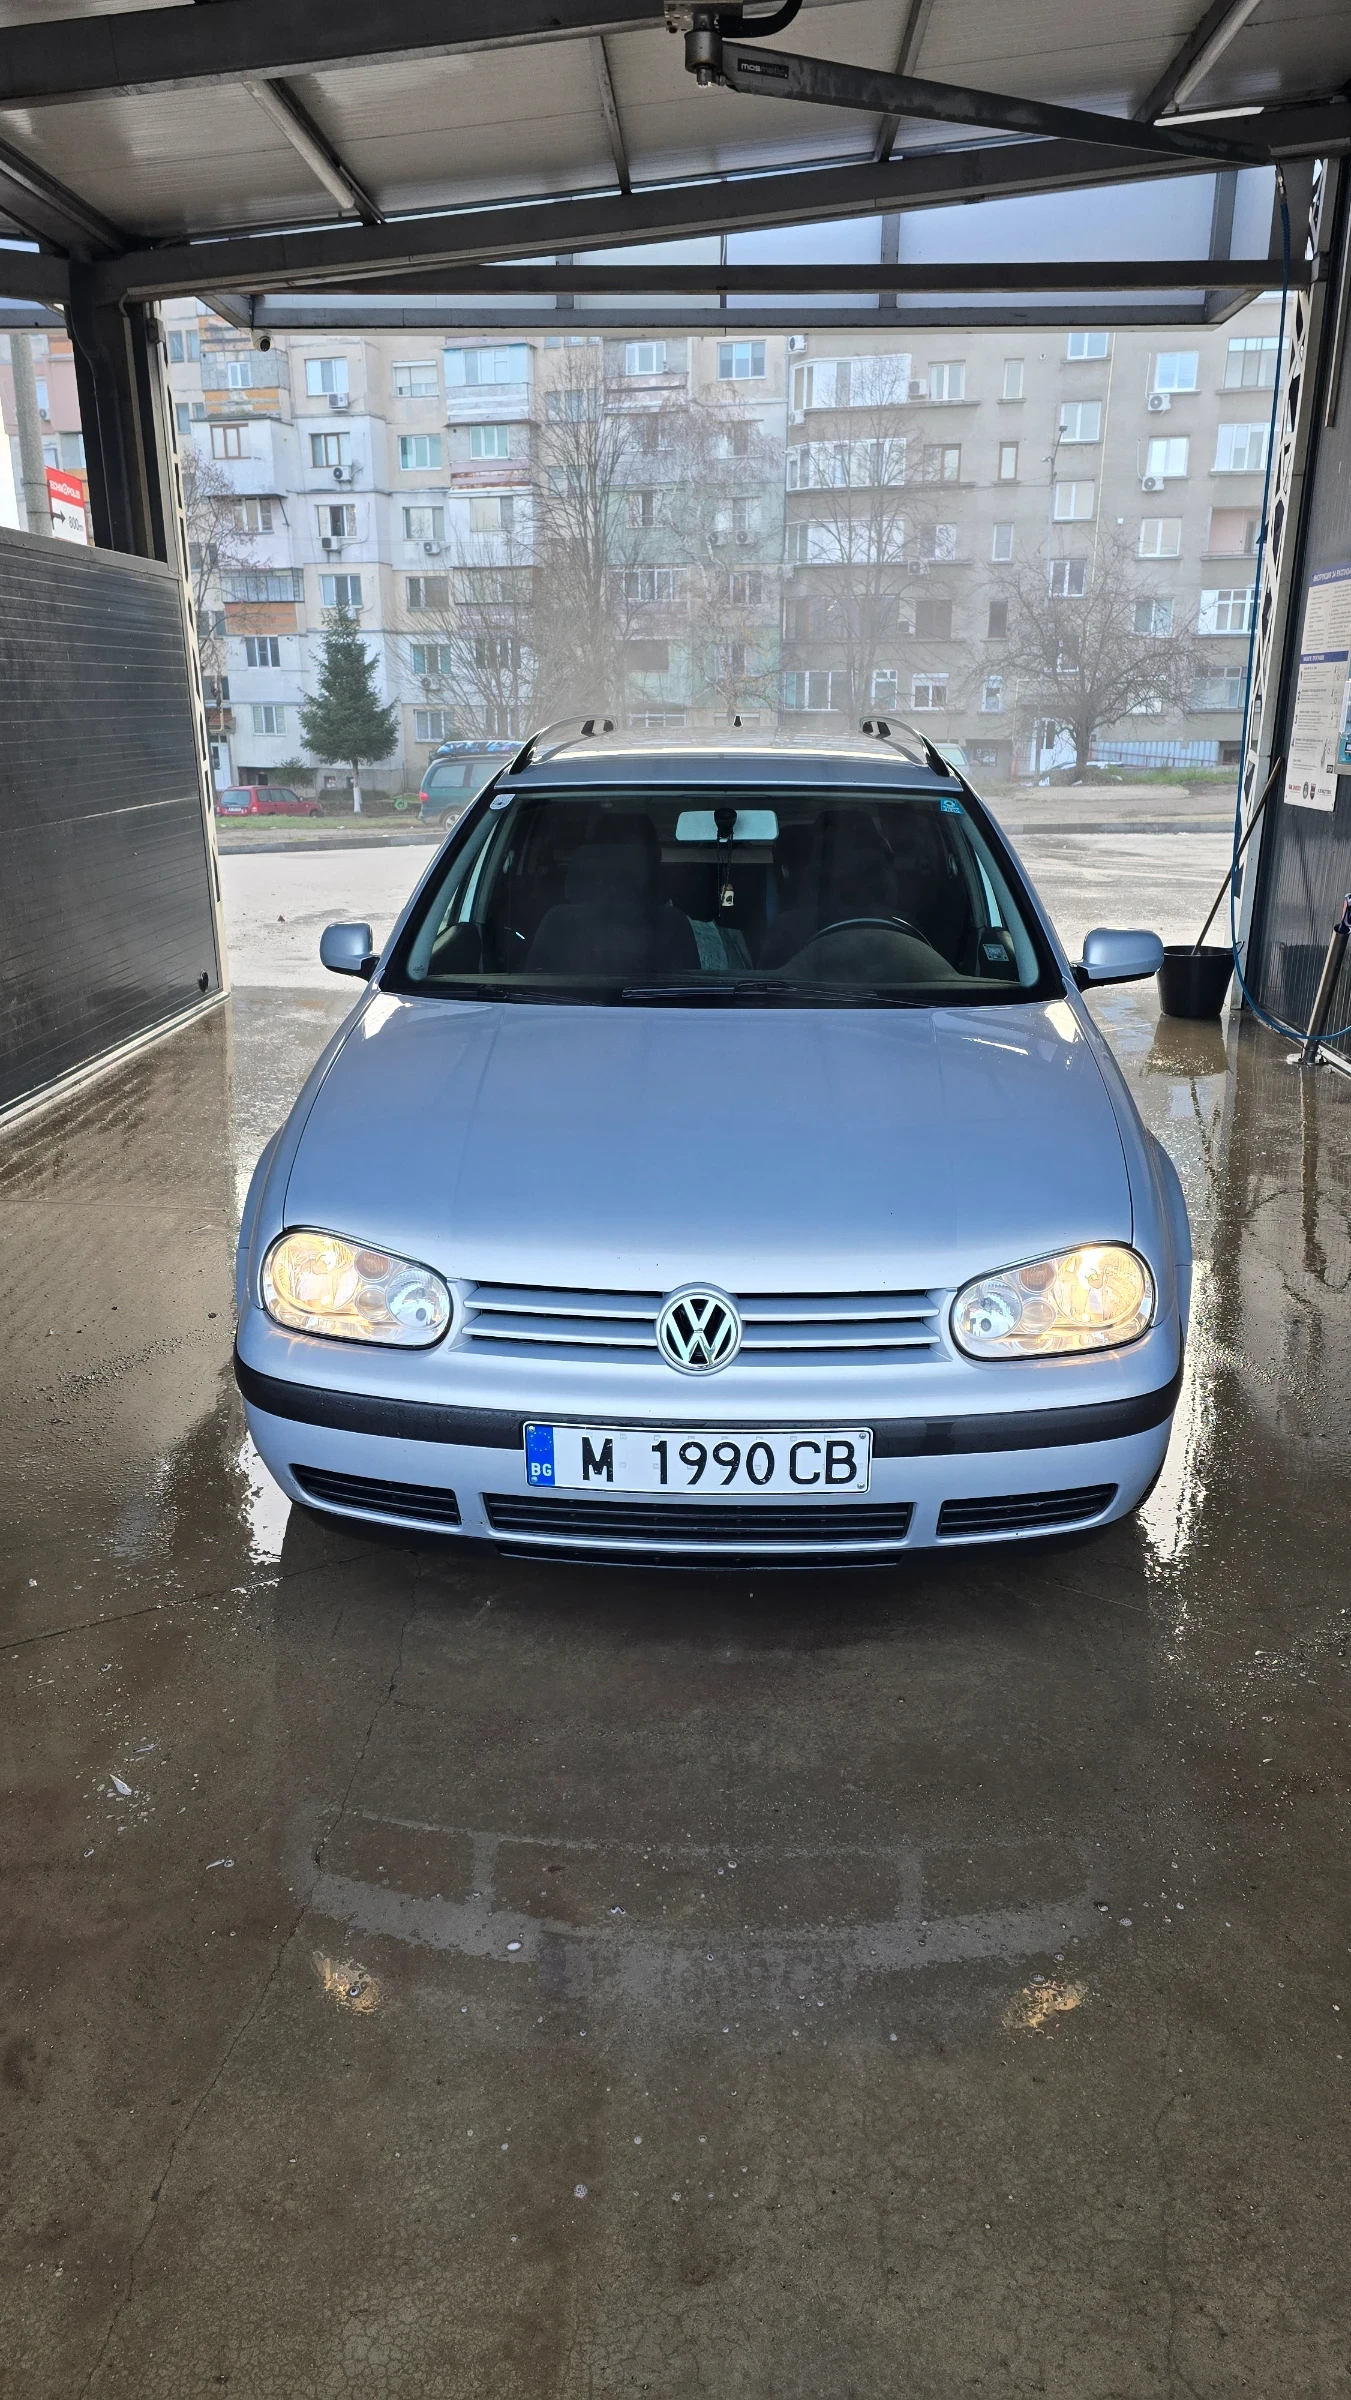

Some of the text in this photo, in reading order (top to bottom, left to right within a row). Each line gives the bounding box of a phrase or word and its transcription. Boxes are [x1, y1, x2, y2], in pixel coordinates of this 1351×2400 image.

[664, 1296, 734, 1366] VW
[530, 1462, 552, 1477] BG
[581, 1436, 857, 1485] M 1990 CB
